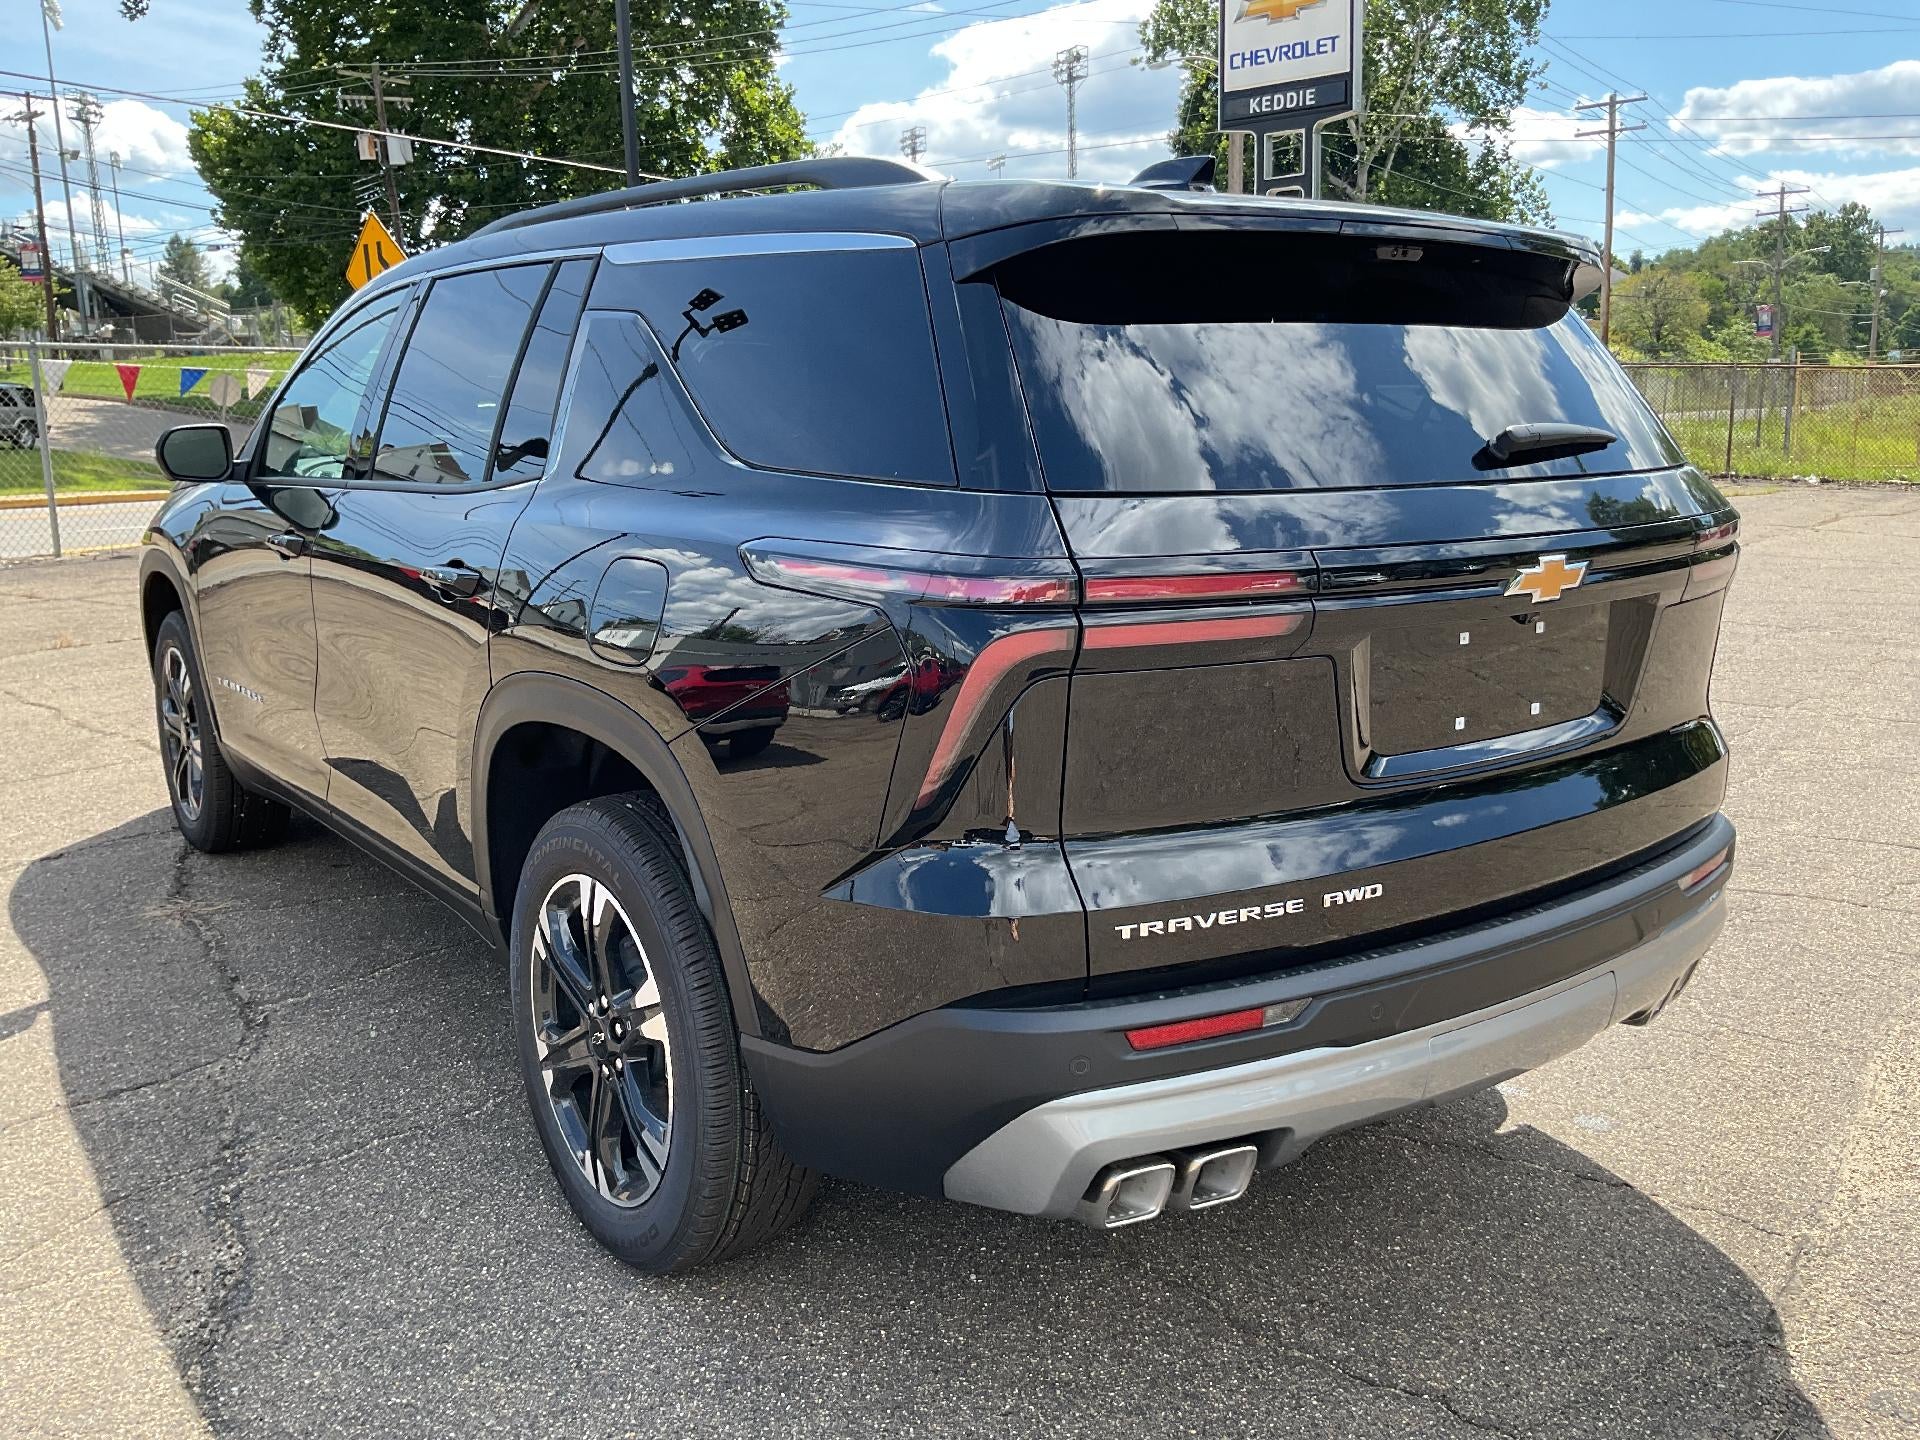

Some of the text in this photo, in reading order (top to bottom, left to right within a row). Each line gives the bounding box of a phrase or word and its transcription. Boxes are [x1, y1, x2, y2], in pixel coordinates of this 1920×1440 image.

[1229, 35, 1340, 70] CHEVROLET
[1250, 88, 1316, 114] KEDDIE
[1114, 883, 1383, 940] TRAVERSE AWD
